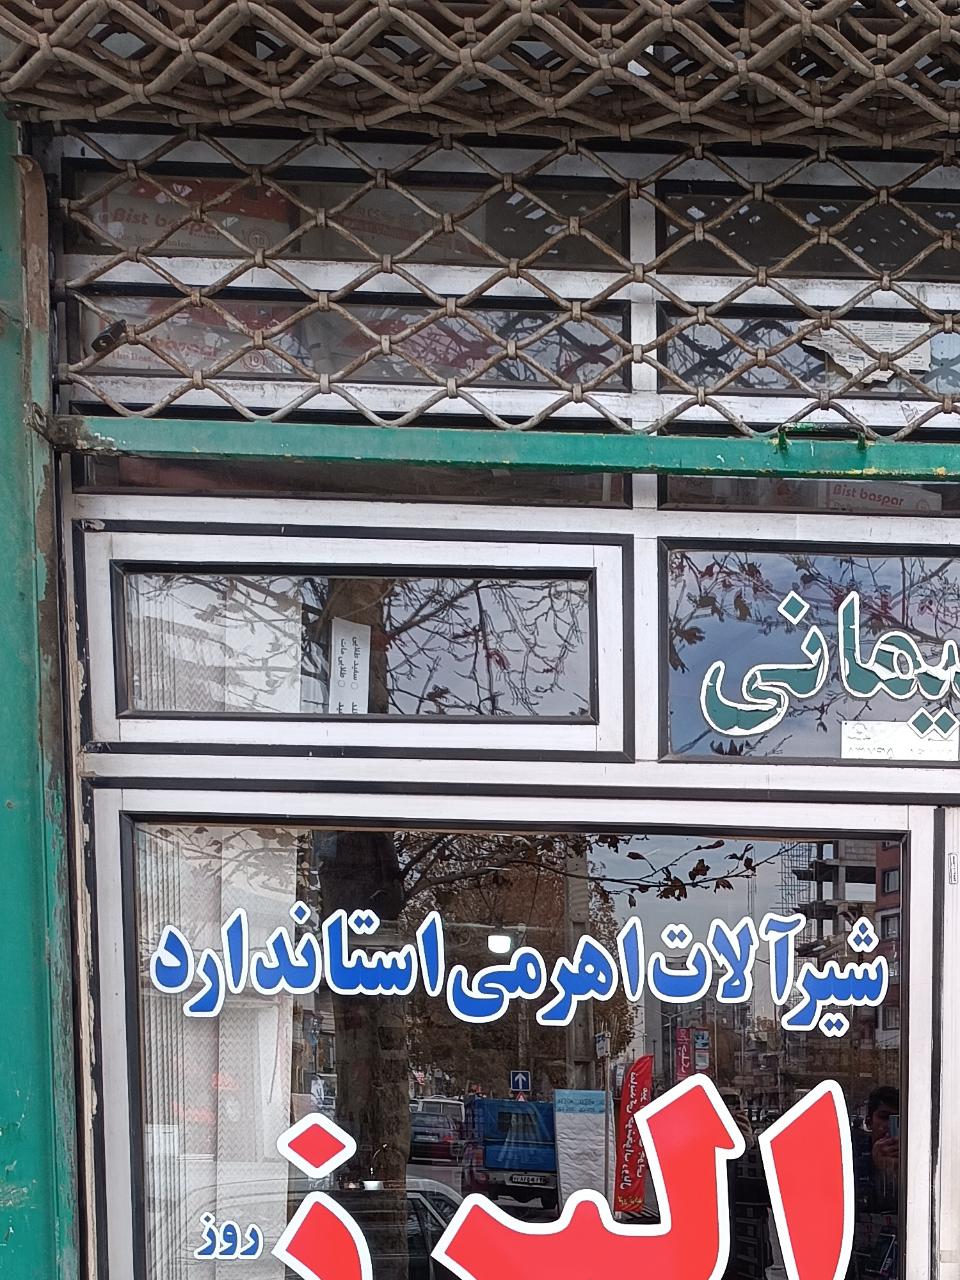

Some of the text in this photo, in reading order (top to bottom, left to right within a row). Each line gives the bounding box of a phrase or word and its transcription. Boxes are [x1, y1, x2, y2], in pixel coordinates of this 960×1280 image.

[151, 902, 445, 1018] استاندارد
[446, 915, 644, 1026] اهرمی
[193, 1211, 264, 1260] روز
